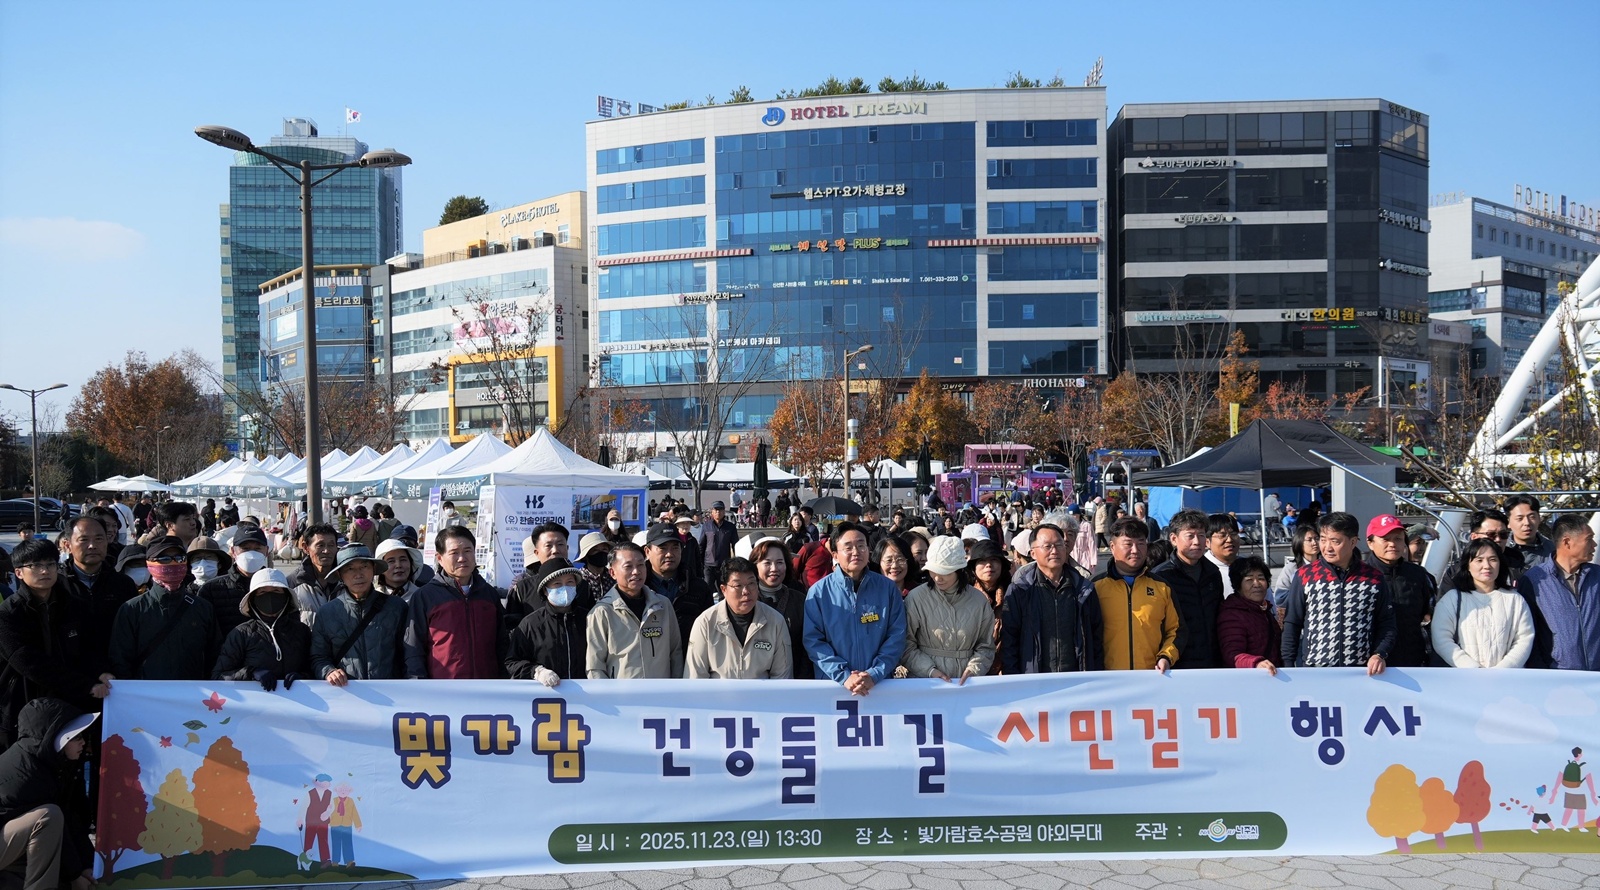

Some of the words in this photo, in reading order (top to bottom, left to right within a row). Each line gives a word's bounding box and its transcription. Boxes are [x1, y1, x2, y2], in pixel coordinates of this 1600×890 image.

[791, 105, 849, 121] HOTEL
[853, 101, 927, 118] DREAM
[1515, 184, 1556, 214] HOTEL
[314, 296, 361, 308] 름드리교회
[555, 304, 564, 336] 궁타이
[750, 336, 781, 345] 아카데미
[525, 495, 545, 509] HS
[505, 515, 518, 525] (유)
[392, 697, 592, 789] 빛가람
[642, 700, 946, 804] 건강둘레길
[997, 707, 1238, 770] 시민걷기
[1290, 700, 1422, 765] 행사
[640, 829, 770, 850] 2025.11.23.(일)
[776, 829, 822, 846] 13:30
[917, 824, 1032, 843] 빛가람호수공원
[1037, 823, 1102, 842] 야외무대
[1135, 823, 1168, 840] 주관
